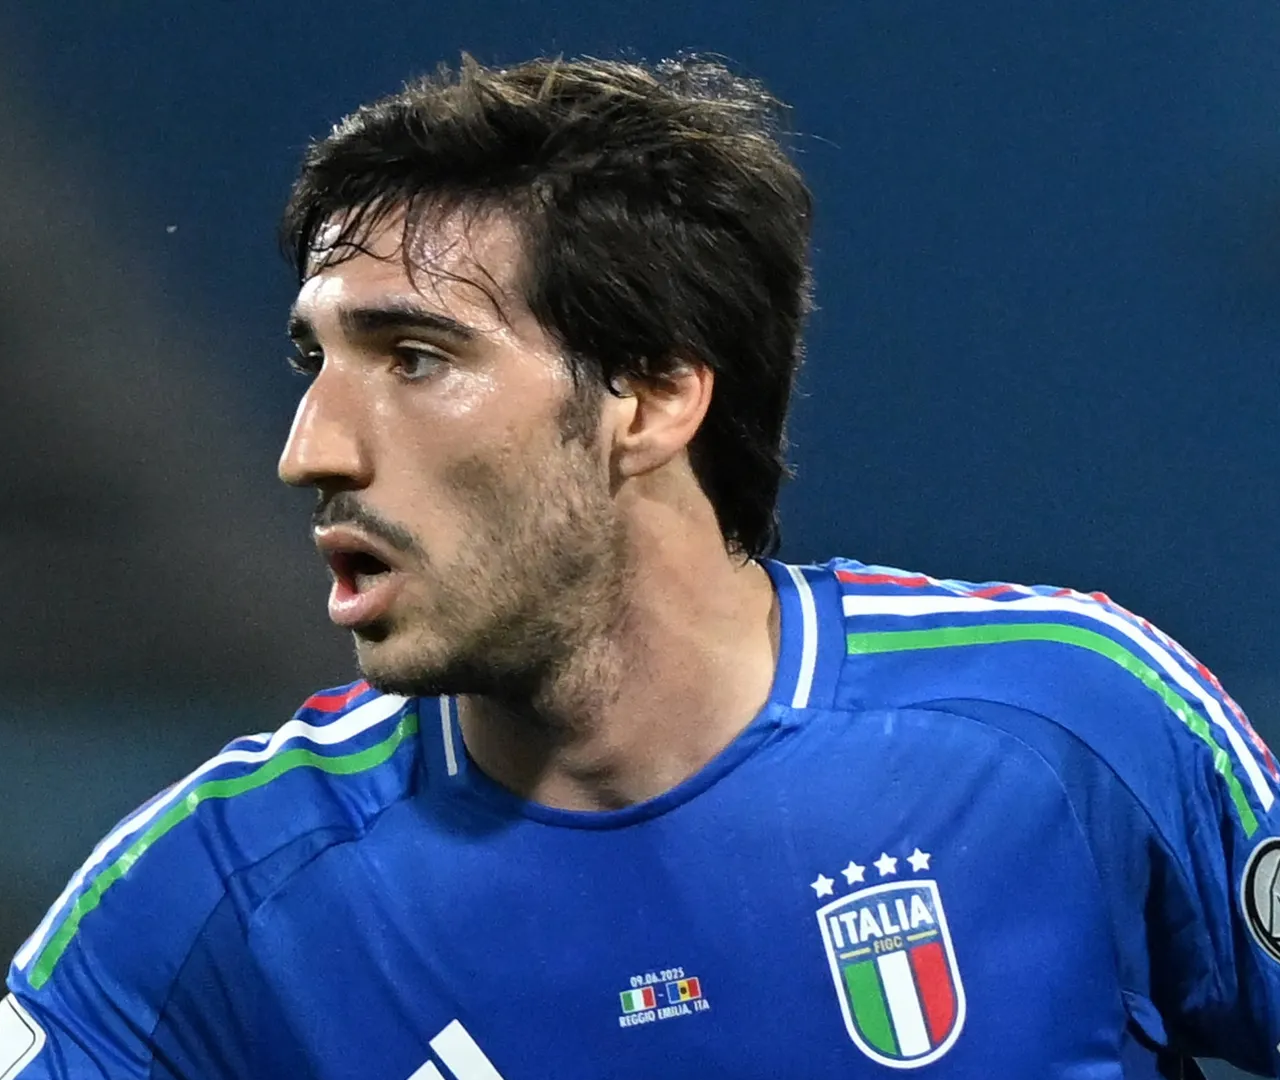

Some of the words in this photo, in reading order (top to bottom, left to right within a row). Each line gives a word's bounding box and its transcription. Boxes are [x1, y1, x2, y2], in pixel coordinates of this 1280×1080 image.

[829, 894, 935, 949] ITALIA
[873, 935, 903, 954] FIGC
[630, 966, 685, 988] 09.06.2025
[618, 1012, 656, 1028] REGGIO
[694, 998, 710, 1012] ITA
